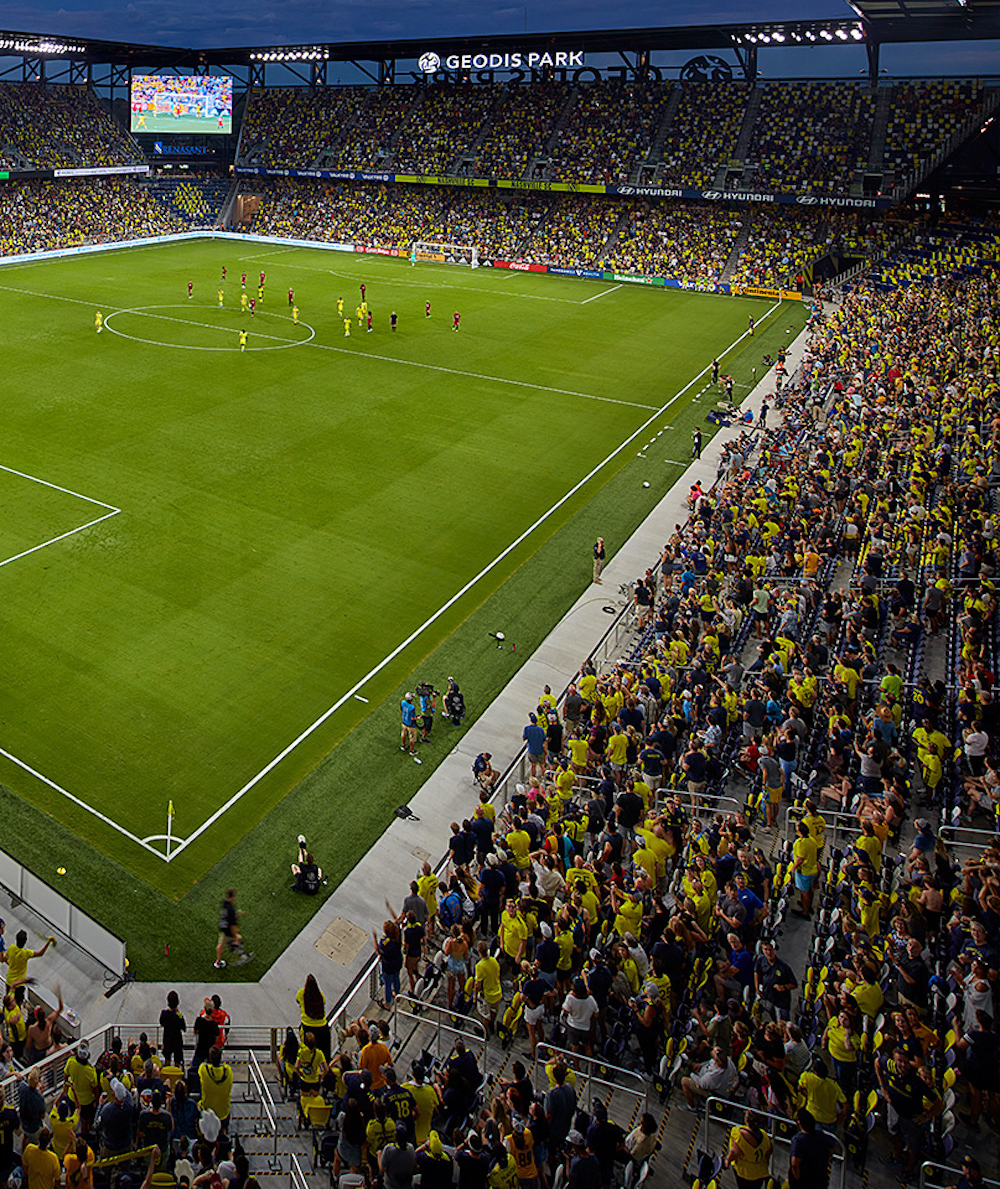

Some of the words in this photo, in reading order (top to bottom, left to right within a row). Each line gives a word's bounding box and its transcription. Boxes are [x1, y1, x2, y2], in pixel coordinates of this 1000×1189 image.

[446, 53, 521, 69] GEODIS
[528, 51, 583, 67] PARK
[636, 188, 682, 197] HYUNDAI
[723, 193, 774, 202] HYUNDAI
[820, 198, 875, 208] HYUNDAI
[395, 1099, 410, 1118] 18
